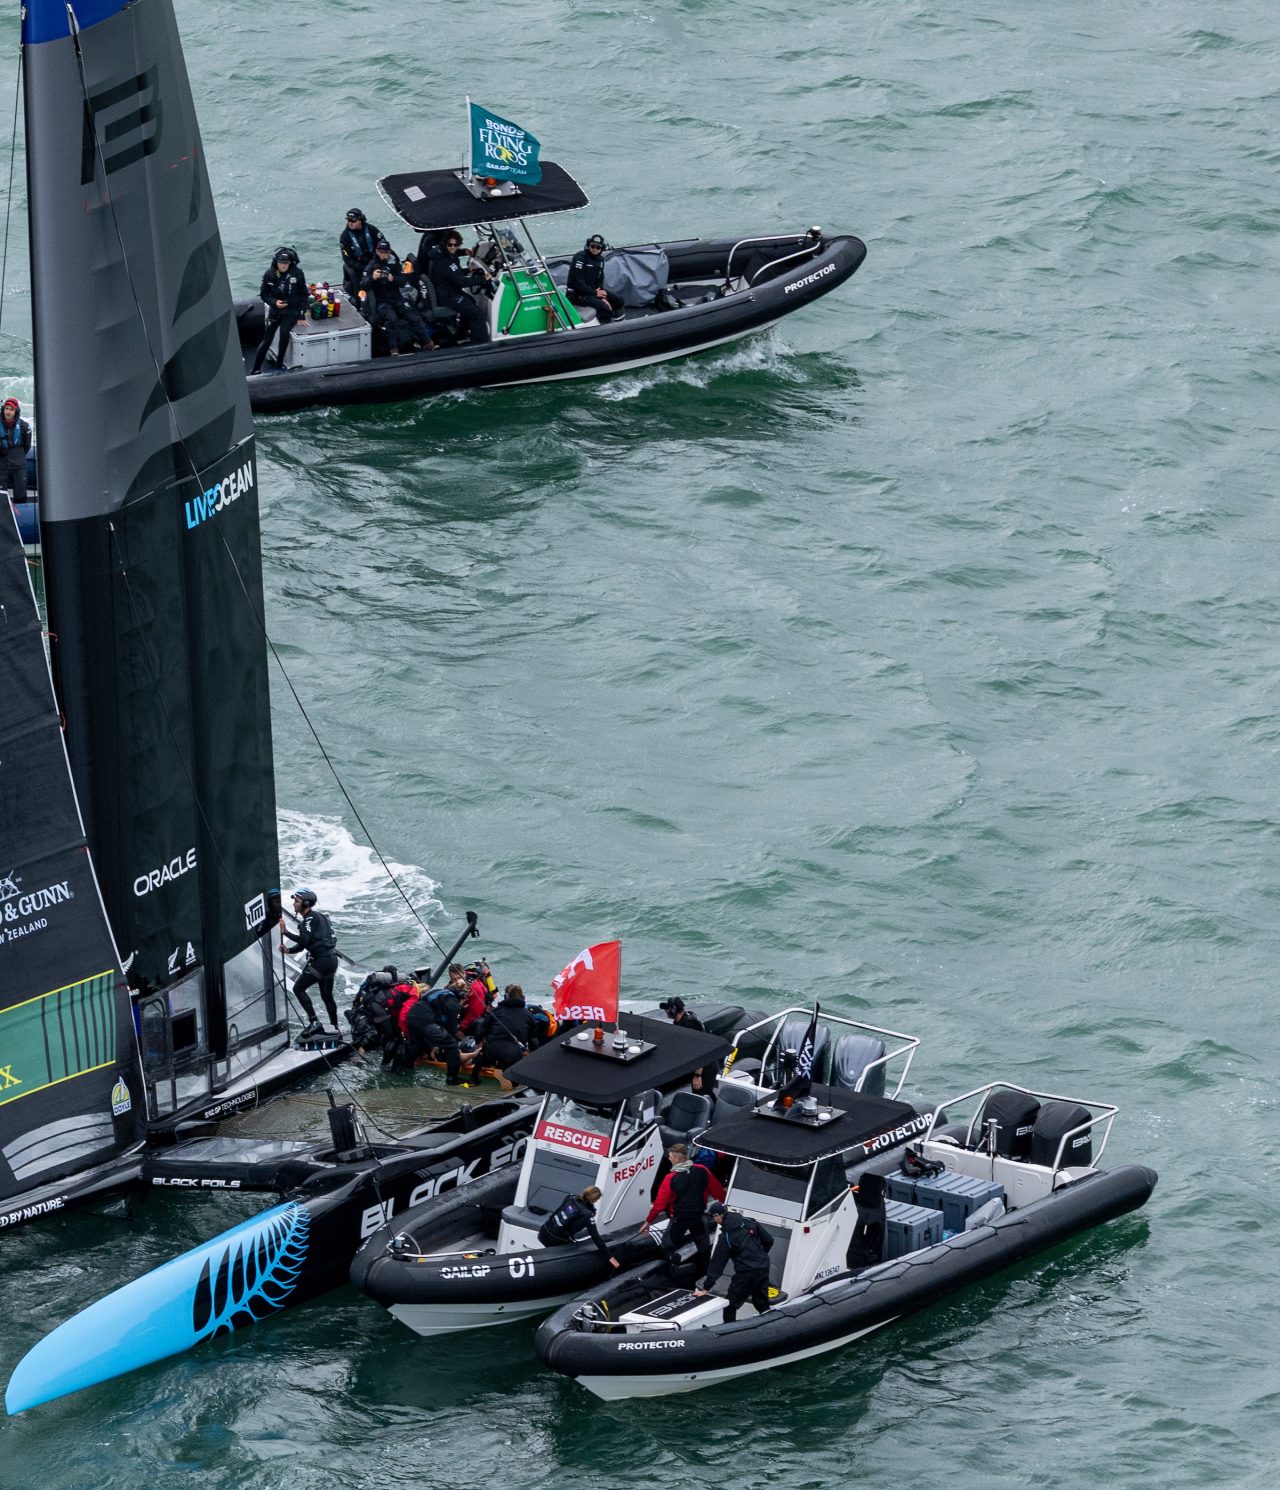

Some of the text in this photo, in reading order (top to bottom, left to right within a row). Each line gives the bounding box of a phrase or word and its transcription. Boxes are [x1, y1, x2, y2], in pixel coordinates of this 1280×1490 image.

[479, 128, 532, 154] FLYING
[485, 143, 527, 166] ROOS
[784, 263, 836, 294] PROTECTOR
[134, 847, 197, 897] ORACLE
[4, 903, 19, 921] &
[7, 918, 48, 941] ZEALAND
[113, 1101, 130, 1114] DOYLE
[221, 1090, 256, 1111] TECHNOLOGIES
[544, 1125, 602, 1150] RESCUE
[613, 1155, 655, 1184] RESCUE
[152, 1177, 241, 1188] BLACK FOILS
[9, 1209, 22, 1224] BY
[440, 1255, 535, 1280] SAILGP 01
[618, 1340, 685, 1351] PROTECTOR
